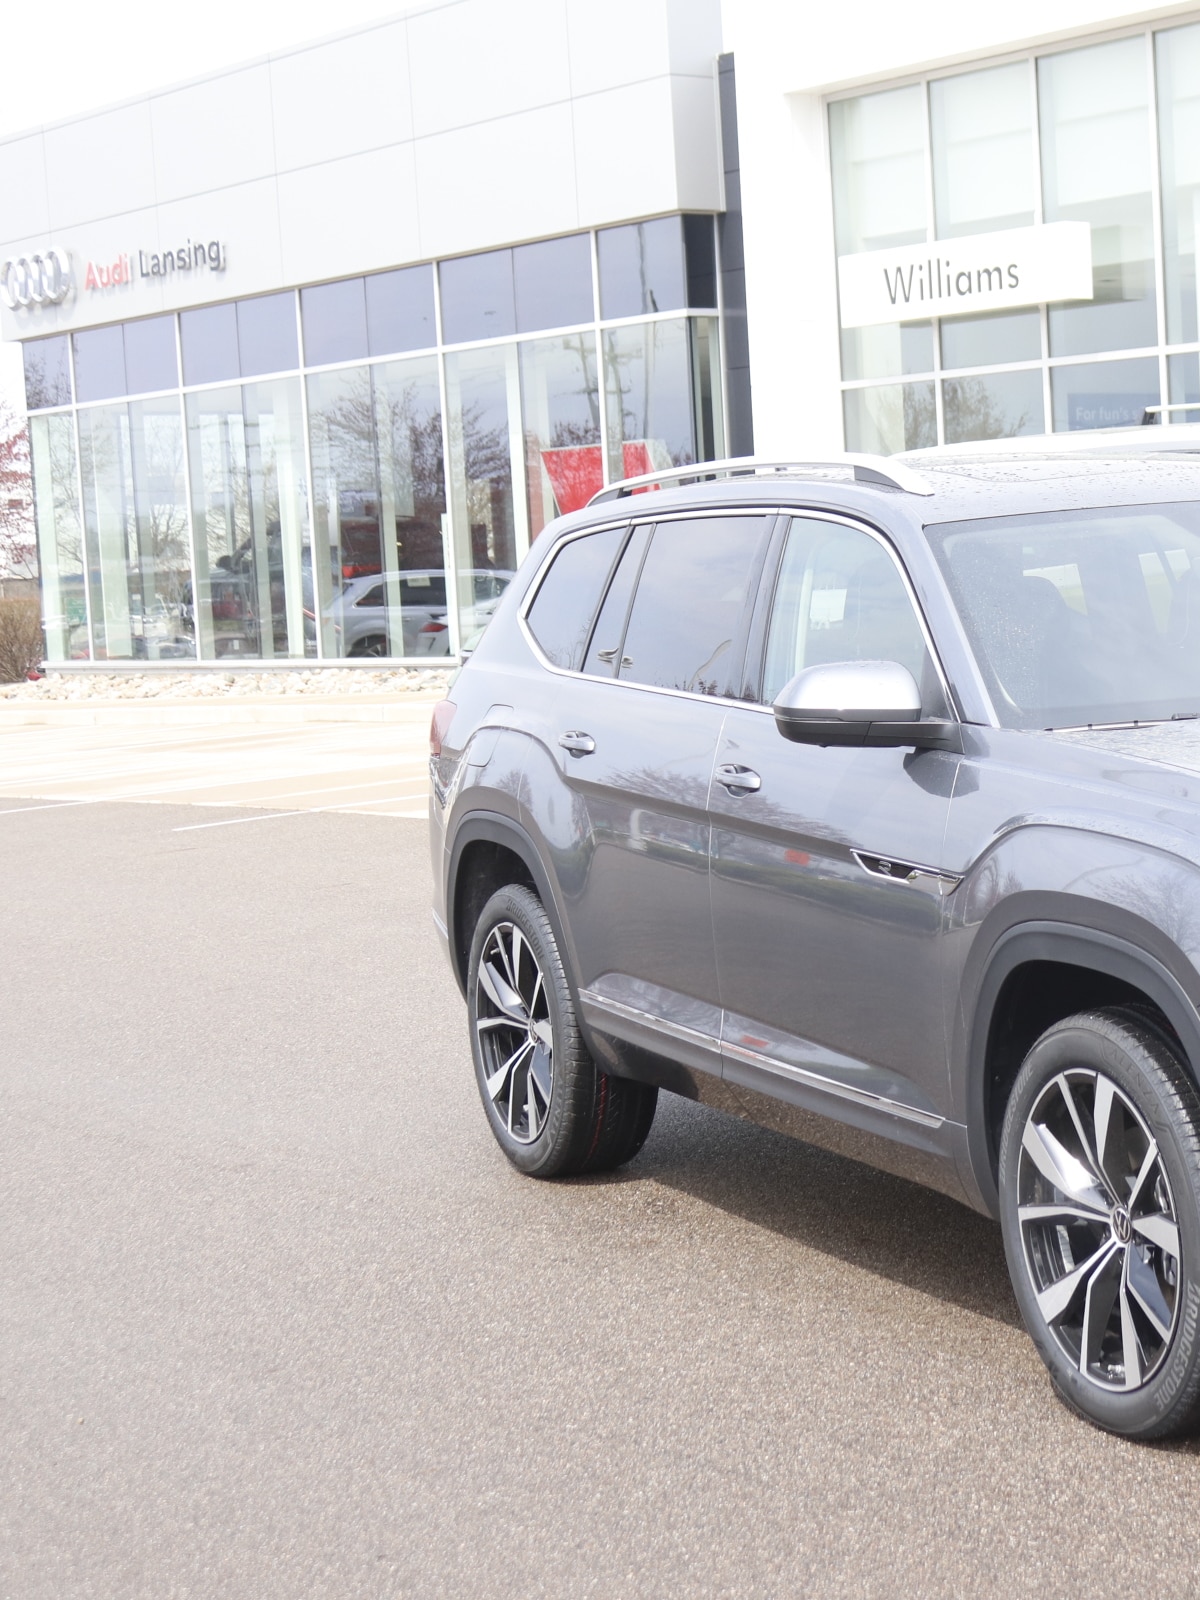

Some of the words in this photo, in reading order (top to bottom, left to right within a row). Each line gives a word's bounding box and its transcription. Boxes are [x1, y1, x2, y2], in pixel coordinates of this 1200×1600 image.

[85, 254, 129, 290] Audi
[138, 238, 221, 278] Lansing
[883, 257, 1020, 305] Williams
[1075, 406, 1096, 420] For
[1099, 405, 1129, 420] fun's
